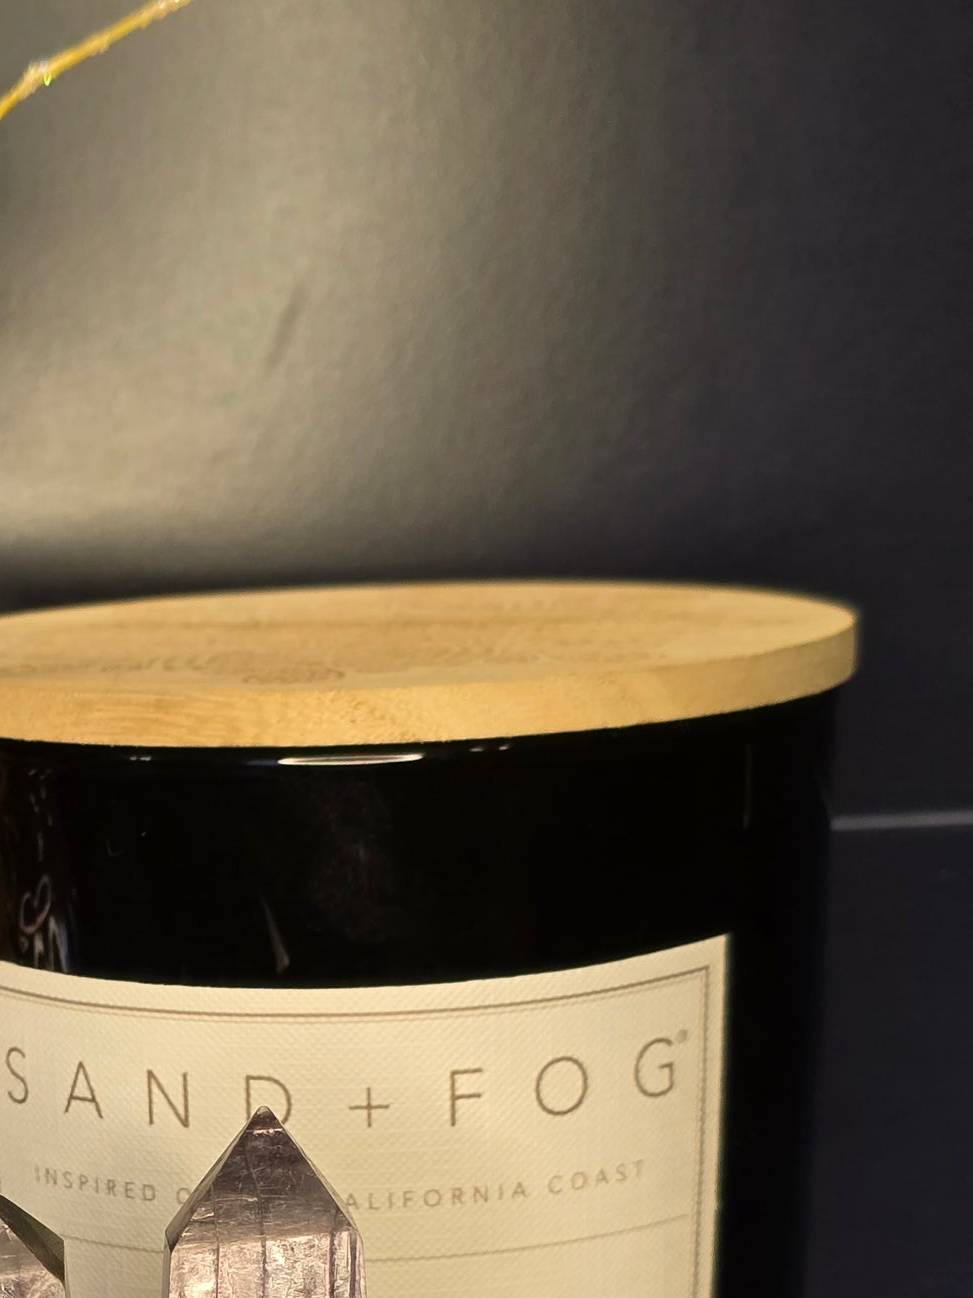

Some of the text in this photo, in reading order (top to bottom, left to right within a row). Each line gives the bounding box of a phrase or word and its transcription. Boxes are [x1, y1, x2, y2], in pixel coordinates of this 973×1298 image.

[5, 1046, 293, 1128] SAND
[34, 1165, 157, 1202] INSPIRED
[344, 1181, 528, 1211] ALIFORNIA
[547, 1158, 644, 1195] COAST
